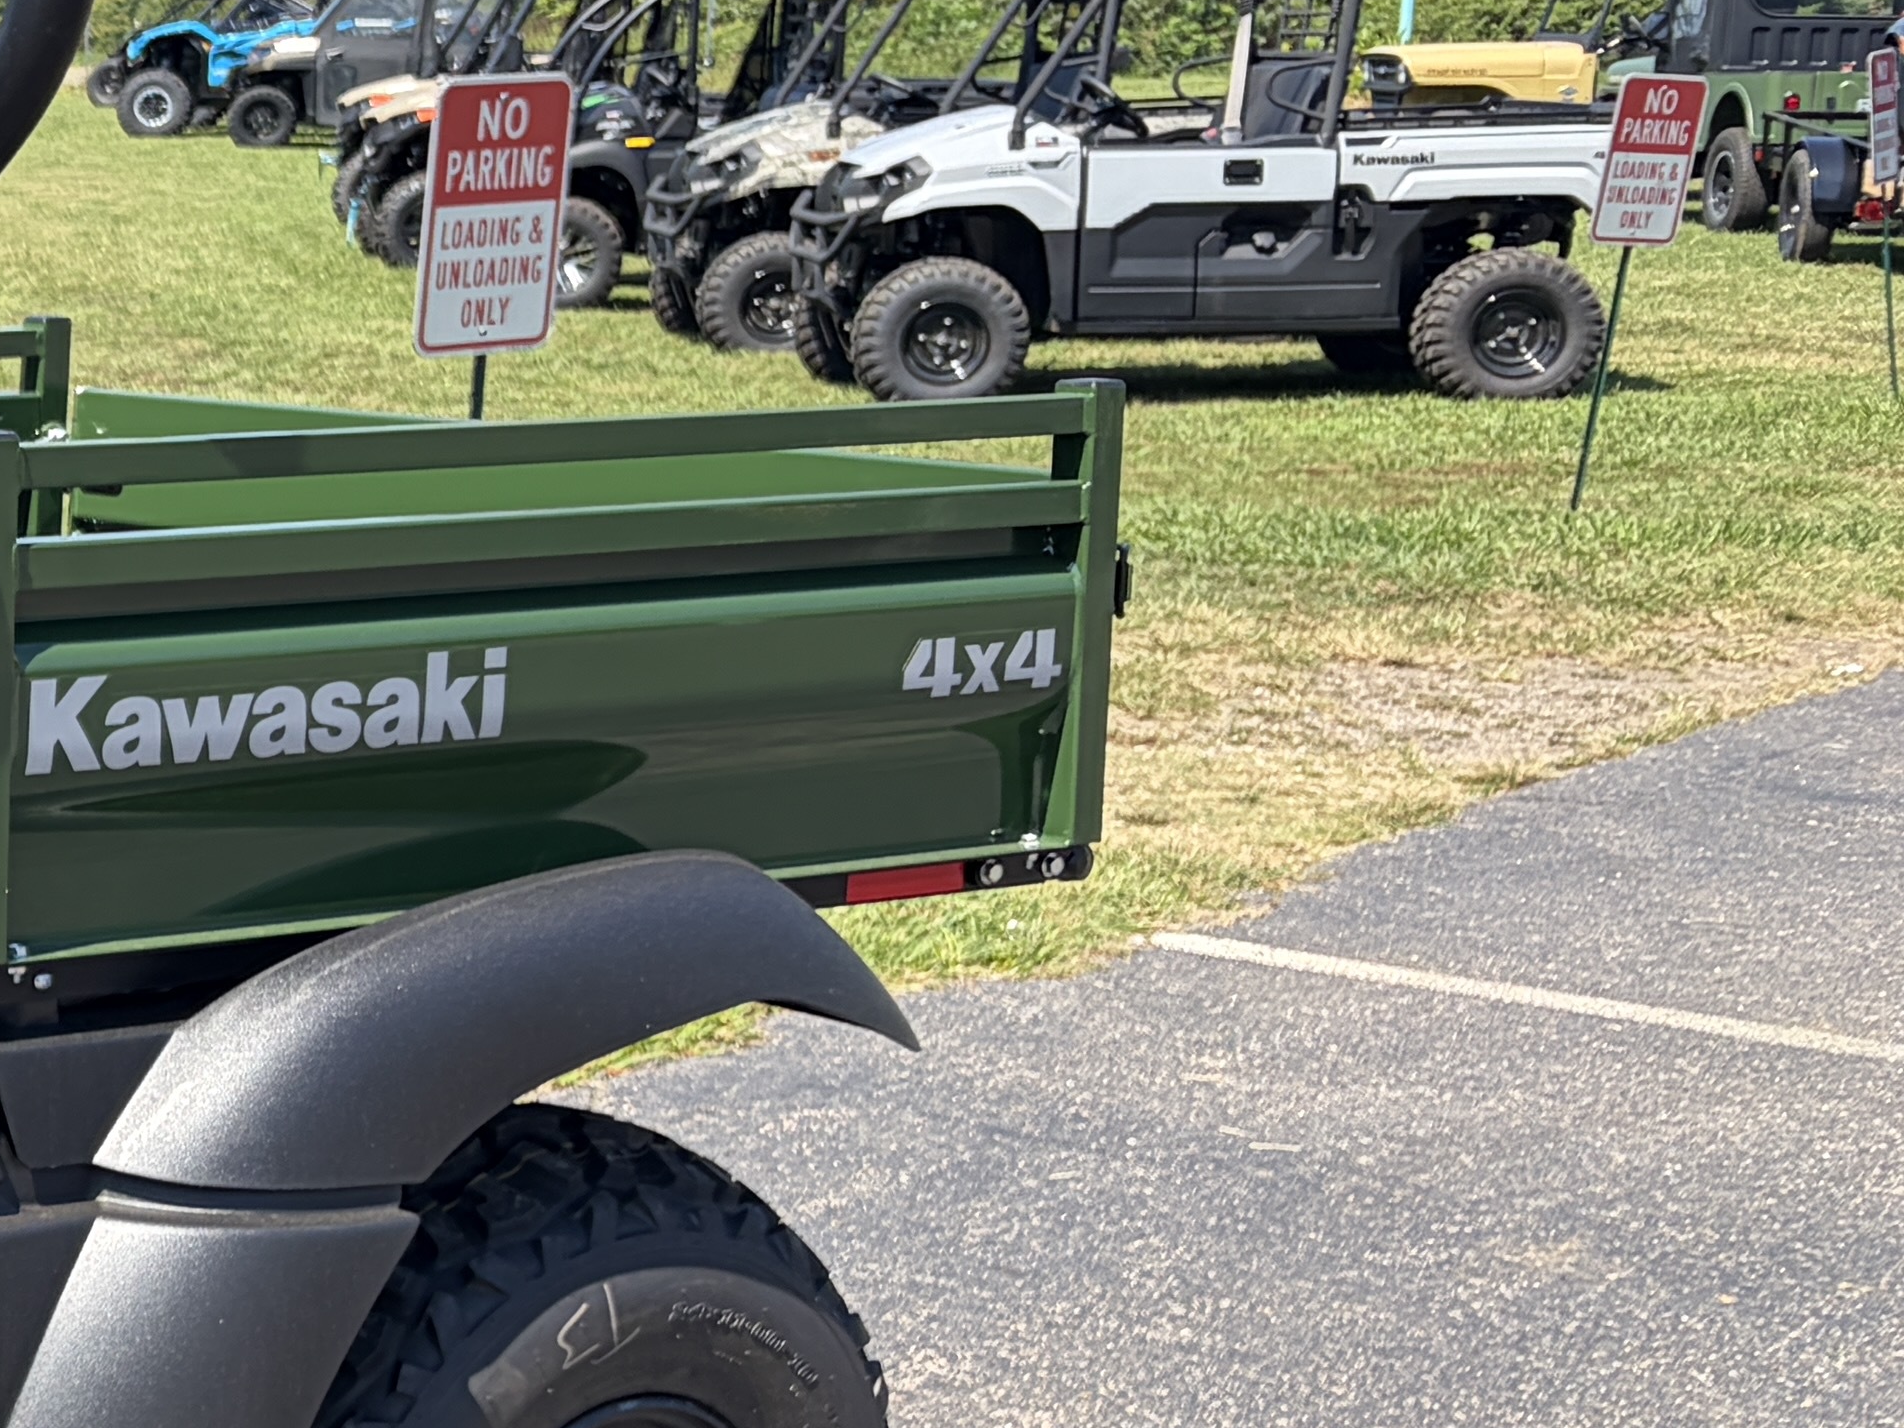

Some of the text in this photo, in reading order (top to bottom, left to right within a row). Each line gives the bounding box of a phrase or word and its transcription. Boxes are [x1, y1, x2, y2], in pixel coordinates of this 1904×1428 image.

[1644, 84, 1680, 115] NO
[477, 97, 531, 142] NO
[1620, 117, 1692, 147] PARKING
[445, 145, 556, 193] PARKING
[1353, 151, 1435, 166] Kawasaki
[1613, 160, 1680, 182] LOADING &
[1606, 184, 1678, 206] UNLOADING
[441, 215, 544, 251] LOADING &
[1619, 210, 1654, 229] ONLY
[435, 254, 544, 291] UNLOADING
[460, 296, 510, 329] ONLY
[901, 628, 1063, 698] 4x4
[24, 646, 509, 776] Kawasaki
